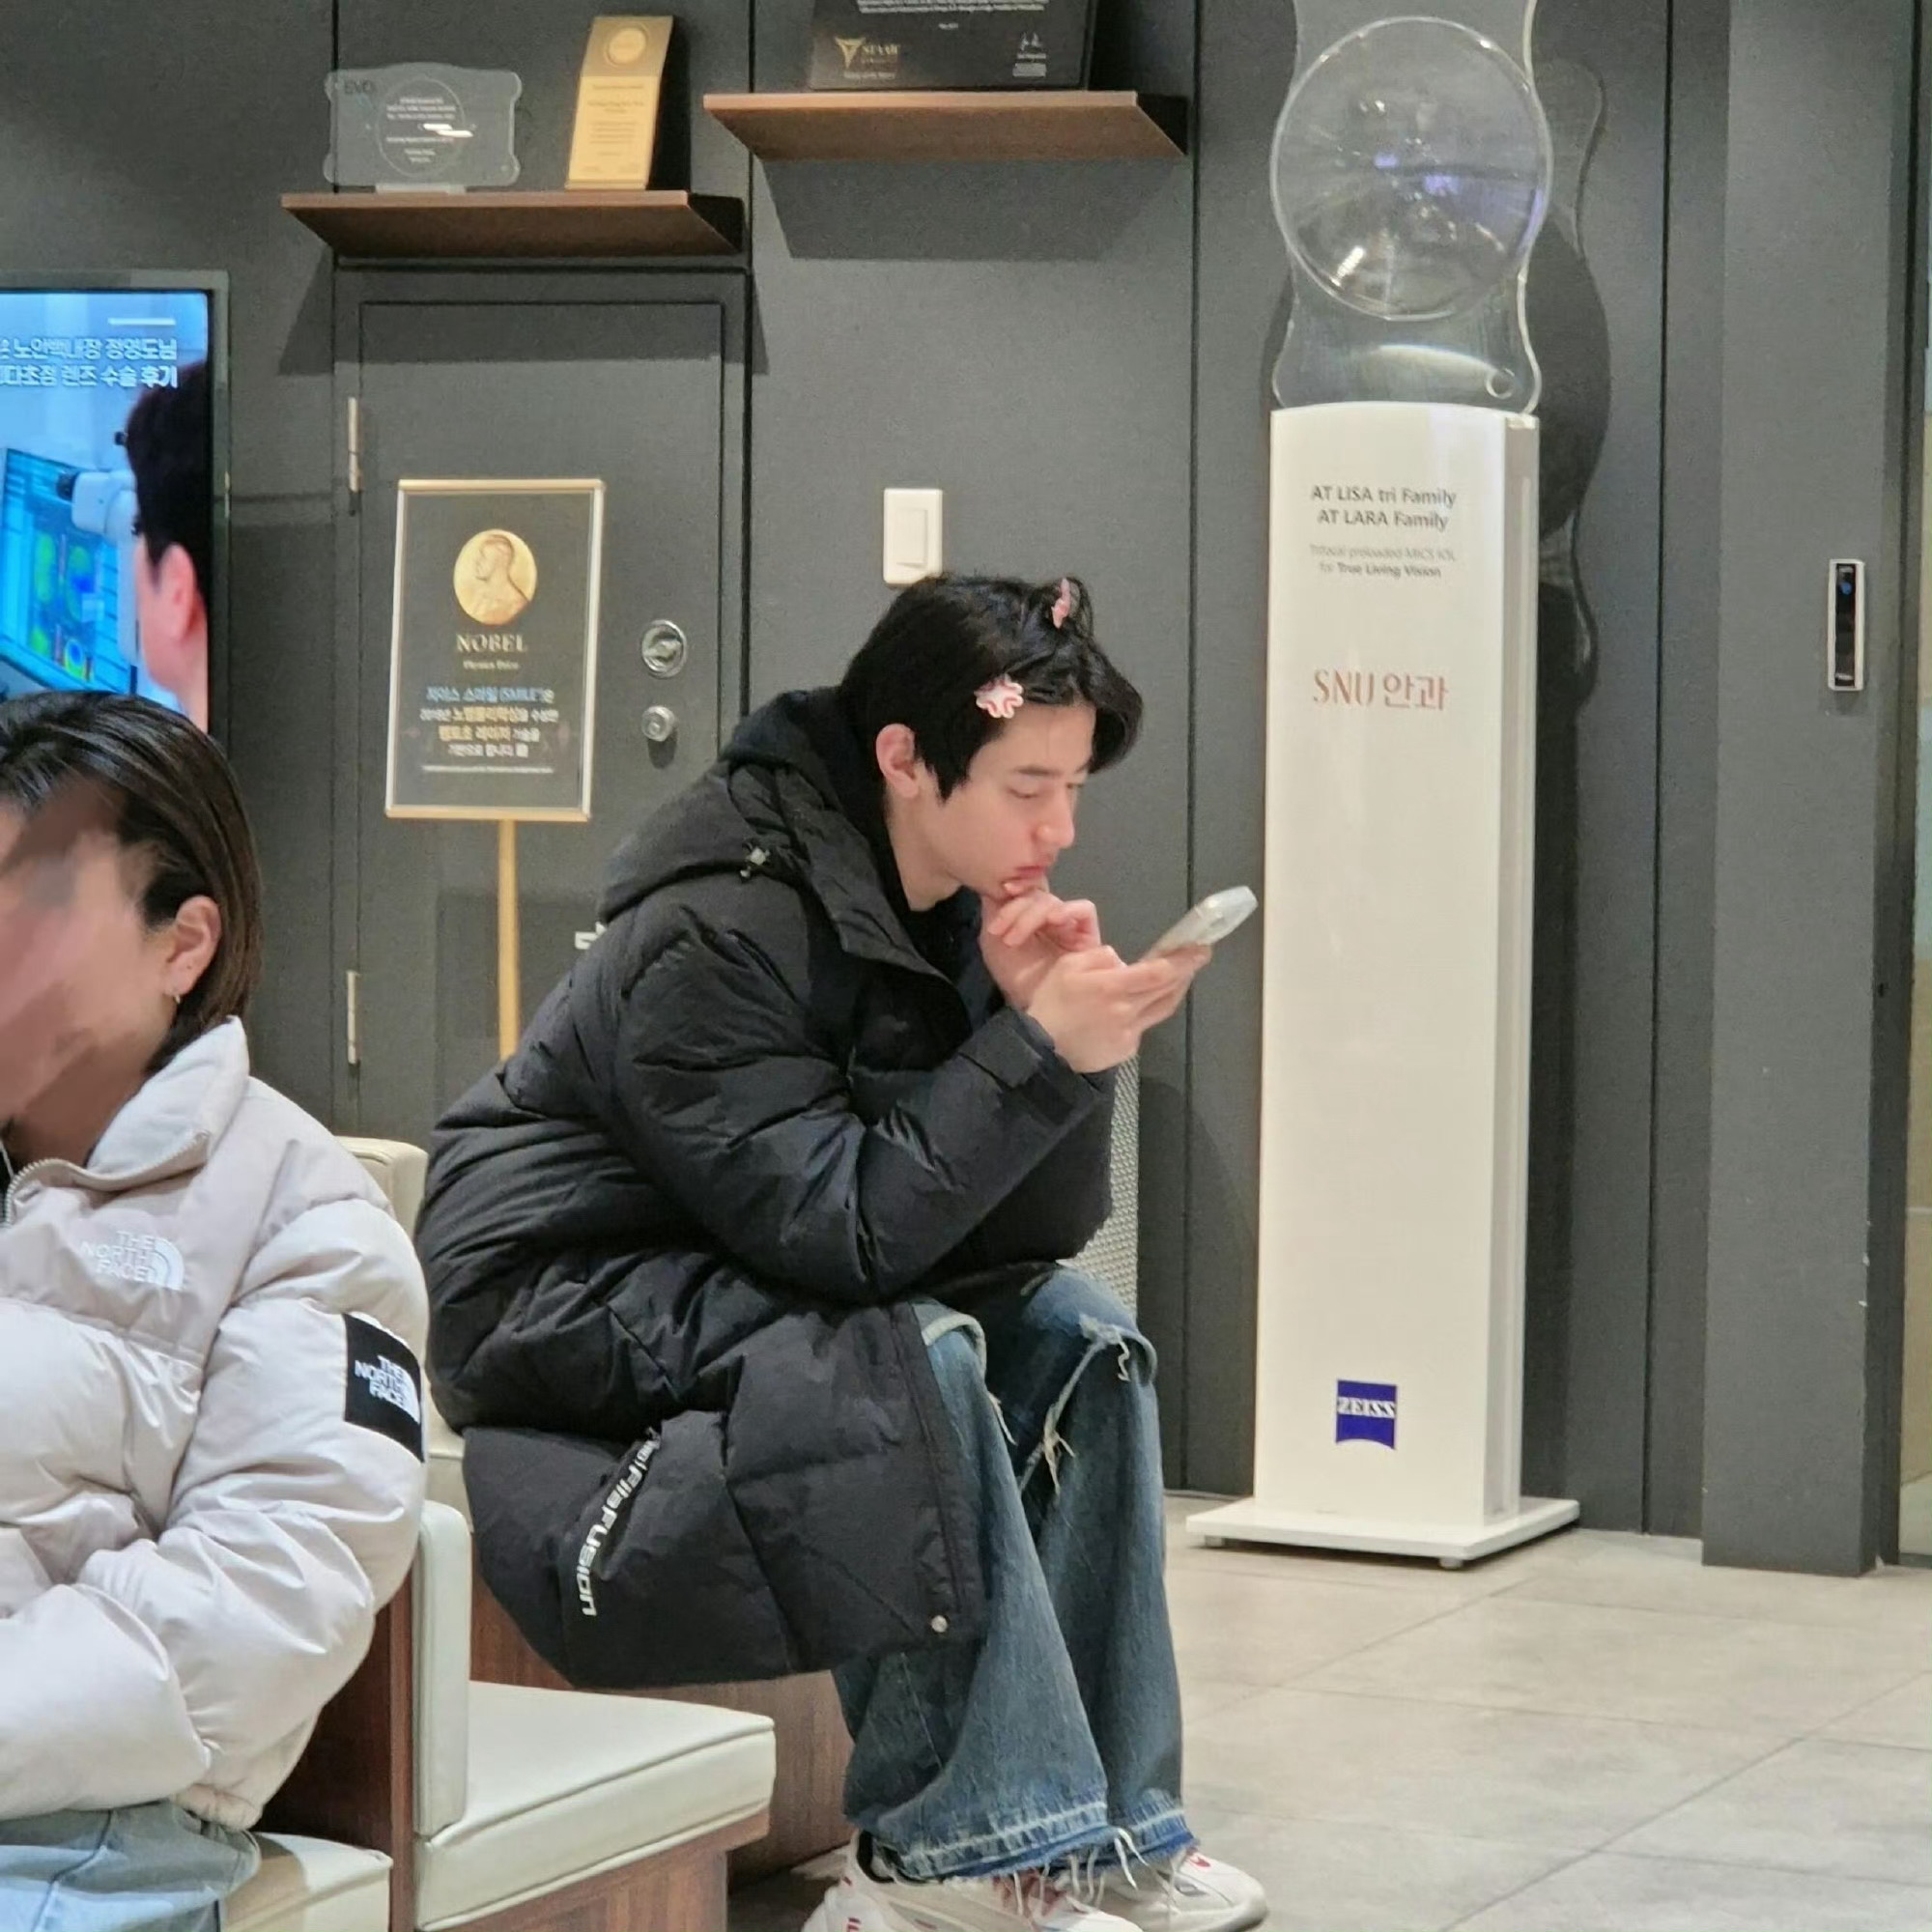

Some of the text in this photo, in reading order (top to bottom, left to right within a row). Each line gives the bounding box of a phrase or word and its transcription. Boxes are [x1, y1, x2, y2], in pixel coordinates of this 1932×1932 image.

[100, 365, 138, 387] 수술
[140, 365, 178, 388] 후기
[1312, 485, 1457, 509] AT LISA tri Family
[1318, 509, 1449, 532] AT LARA Family
[456, 633, 526, 653] NOBEL
[1313, 668, 1450, 711] SNU 안과
[117, 1231, 155, 1249] THE
[79, 1241, 150, 1264] NORTH
[97, 1259, 150, 1282] FACE
[355, 1359, 405, 1394] NORTH
[377, 1354, 405, 1382] THE
[369, 1379, 405, 1409] FACE
[1337, 1397, 1397, 1418] ZEISS
